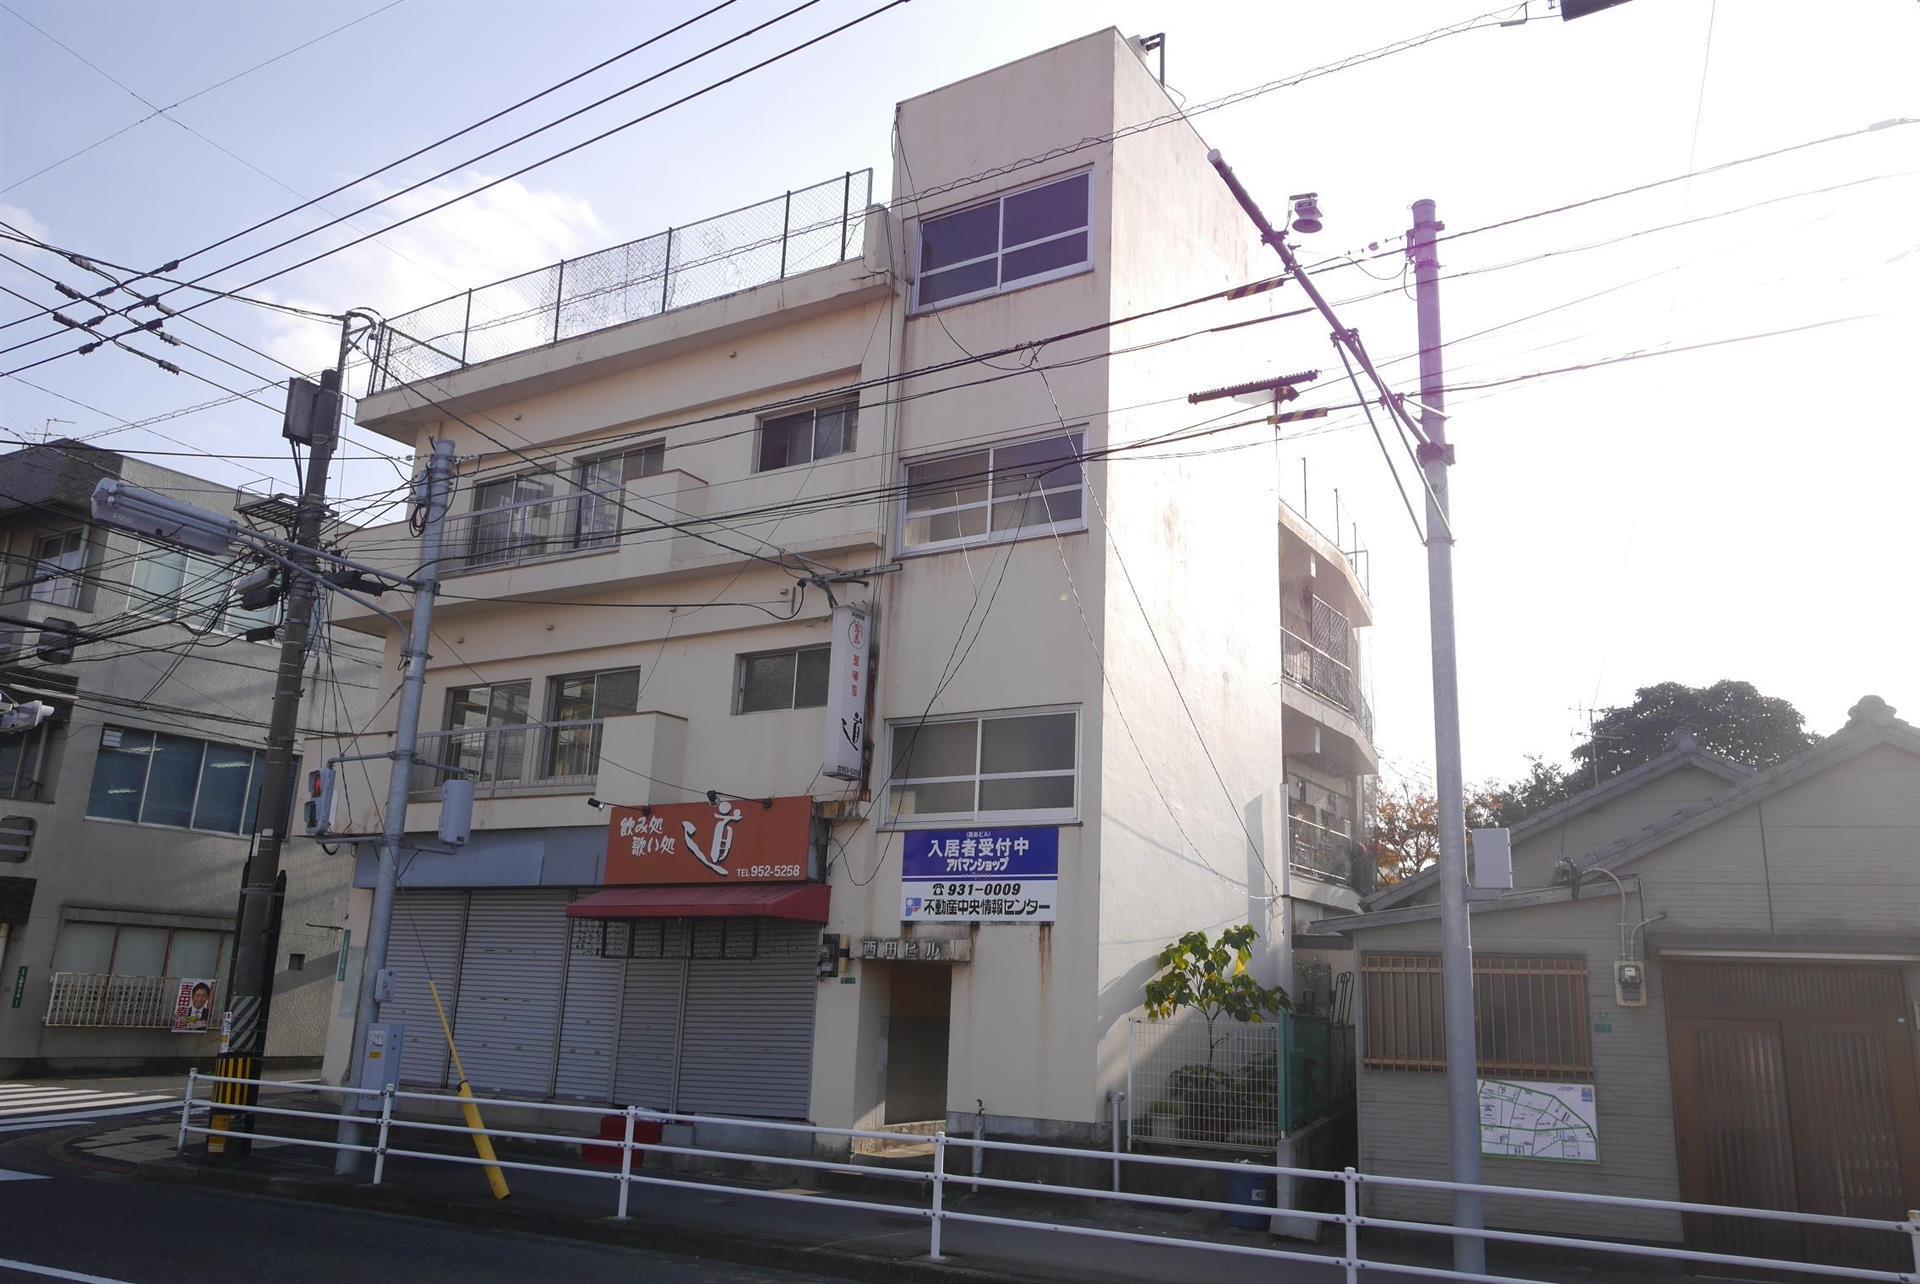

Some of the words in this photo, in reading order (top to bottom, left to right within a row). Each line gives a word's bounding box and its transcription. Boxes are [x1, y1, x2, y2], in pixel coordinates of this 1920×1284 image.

[620, 815, 663, 837] 飲み処
[632, 835, 675, 857] 歌い処
[927, 837, 1029, 858] 入居者受付中
[736, 868, 750, 878] TEL
[751, 865, 800, 877] 952-5258
[946, 857, 1009, 872] アパマンショップ
[948, 883, 1021, 896] 931-0009
[924, 898, 1050, 915] 不動産中央情報センター
[864, 939, 940, 960] 西田ビル
